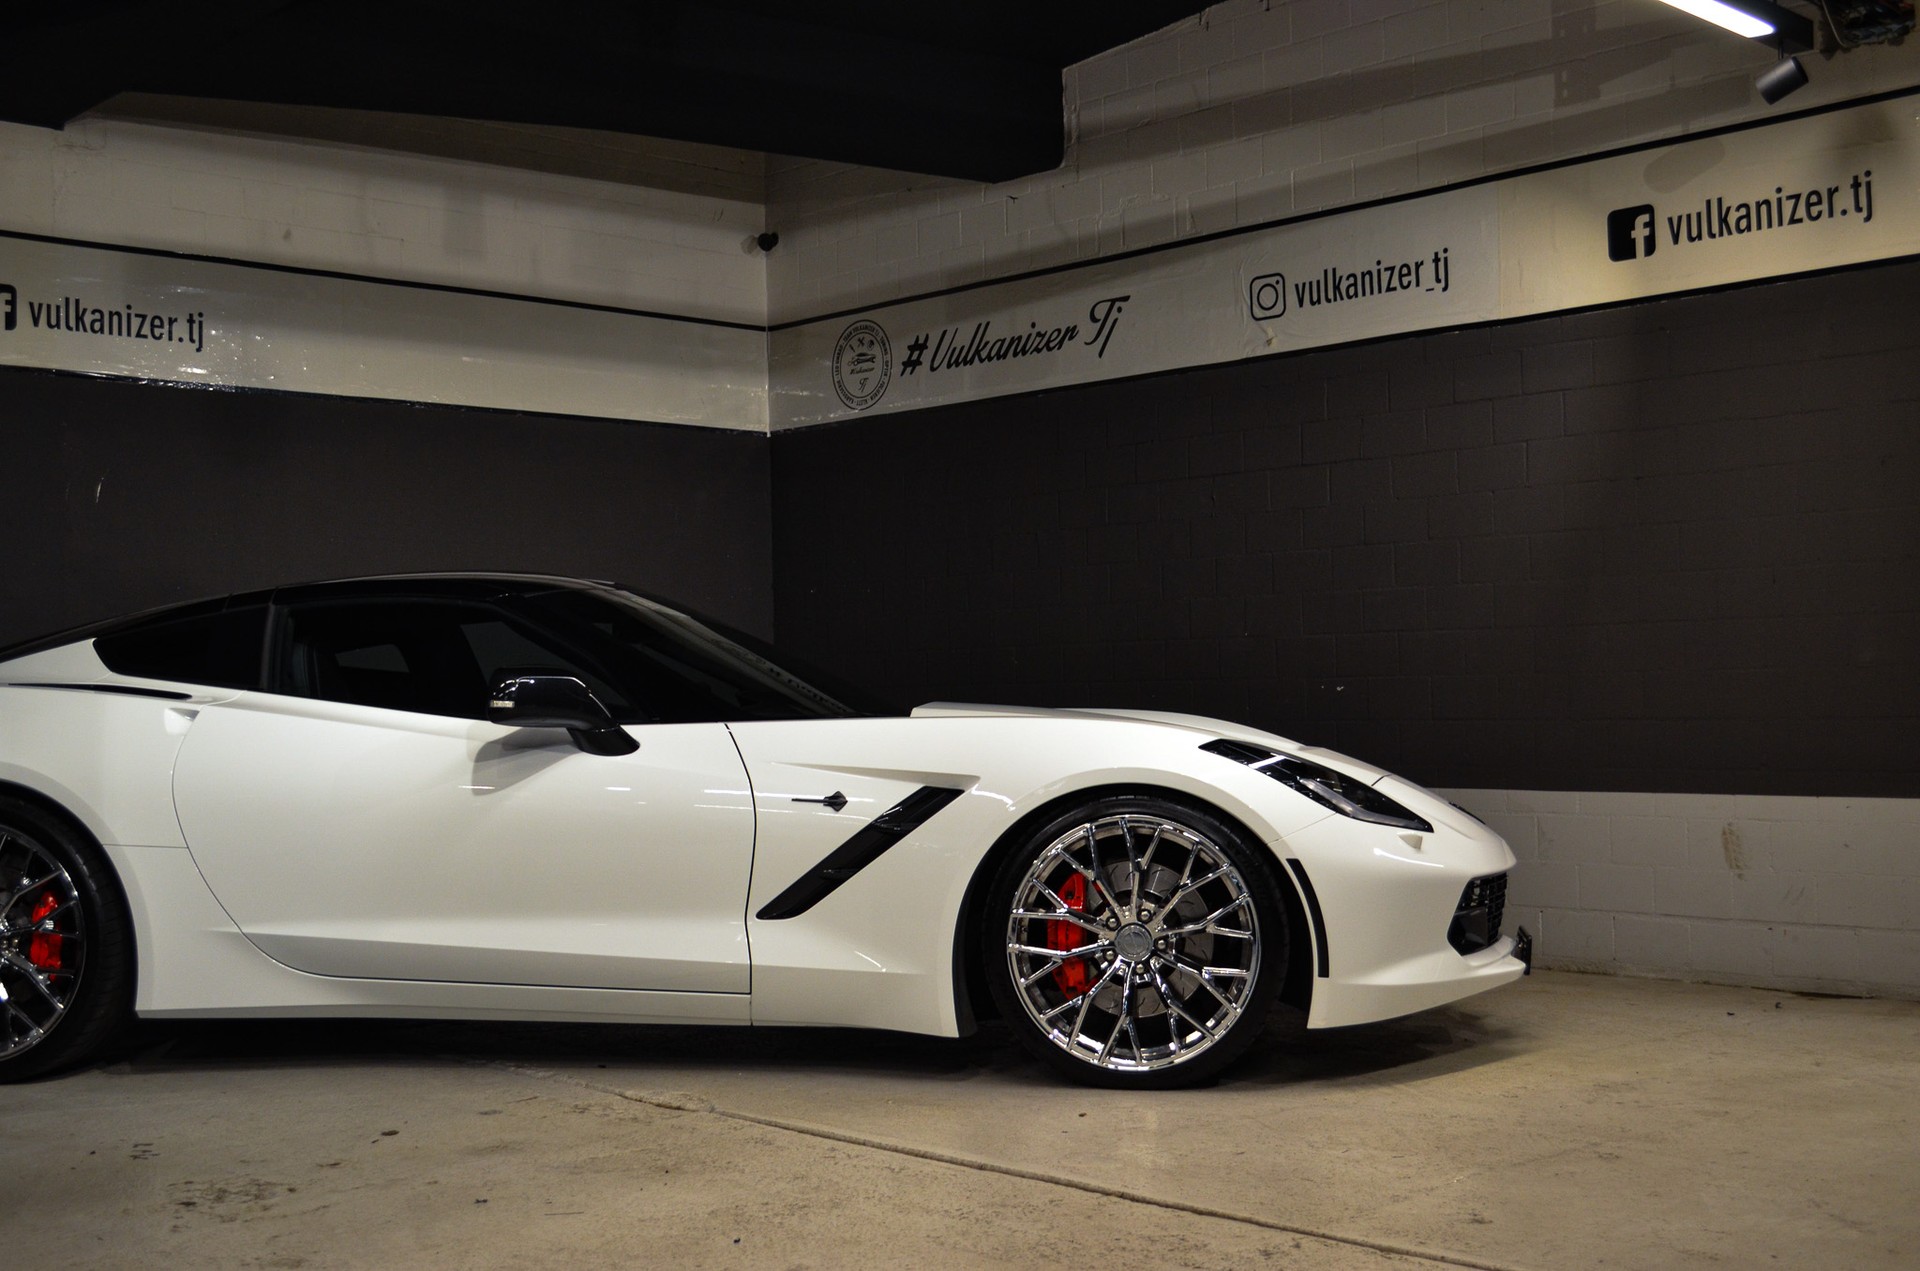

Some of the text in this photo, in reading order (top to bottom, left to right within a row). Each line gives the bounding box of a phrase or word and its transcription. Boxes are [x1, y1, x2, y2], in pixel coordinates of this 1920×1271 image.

[1667, 170, 1873, 245] vulkanizer.tj
[1294, 247, 1449, 308] vulkanizer_tj
[28, 297, 204, 352] vulkanizer.tj
